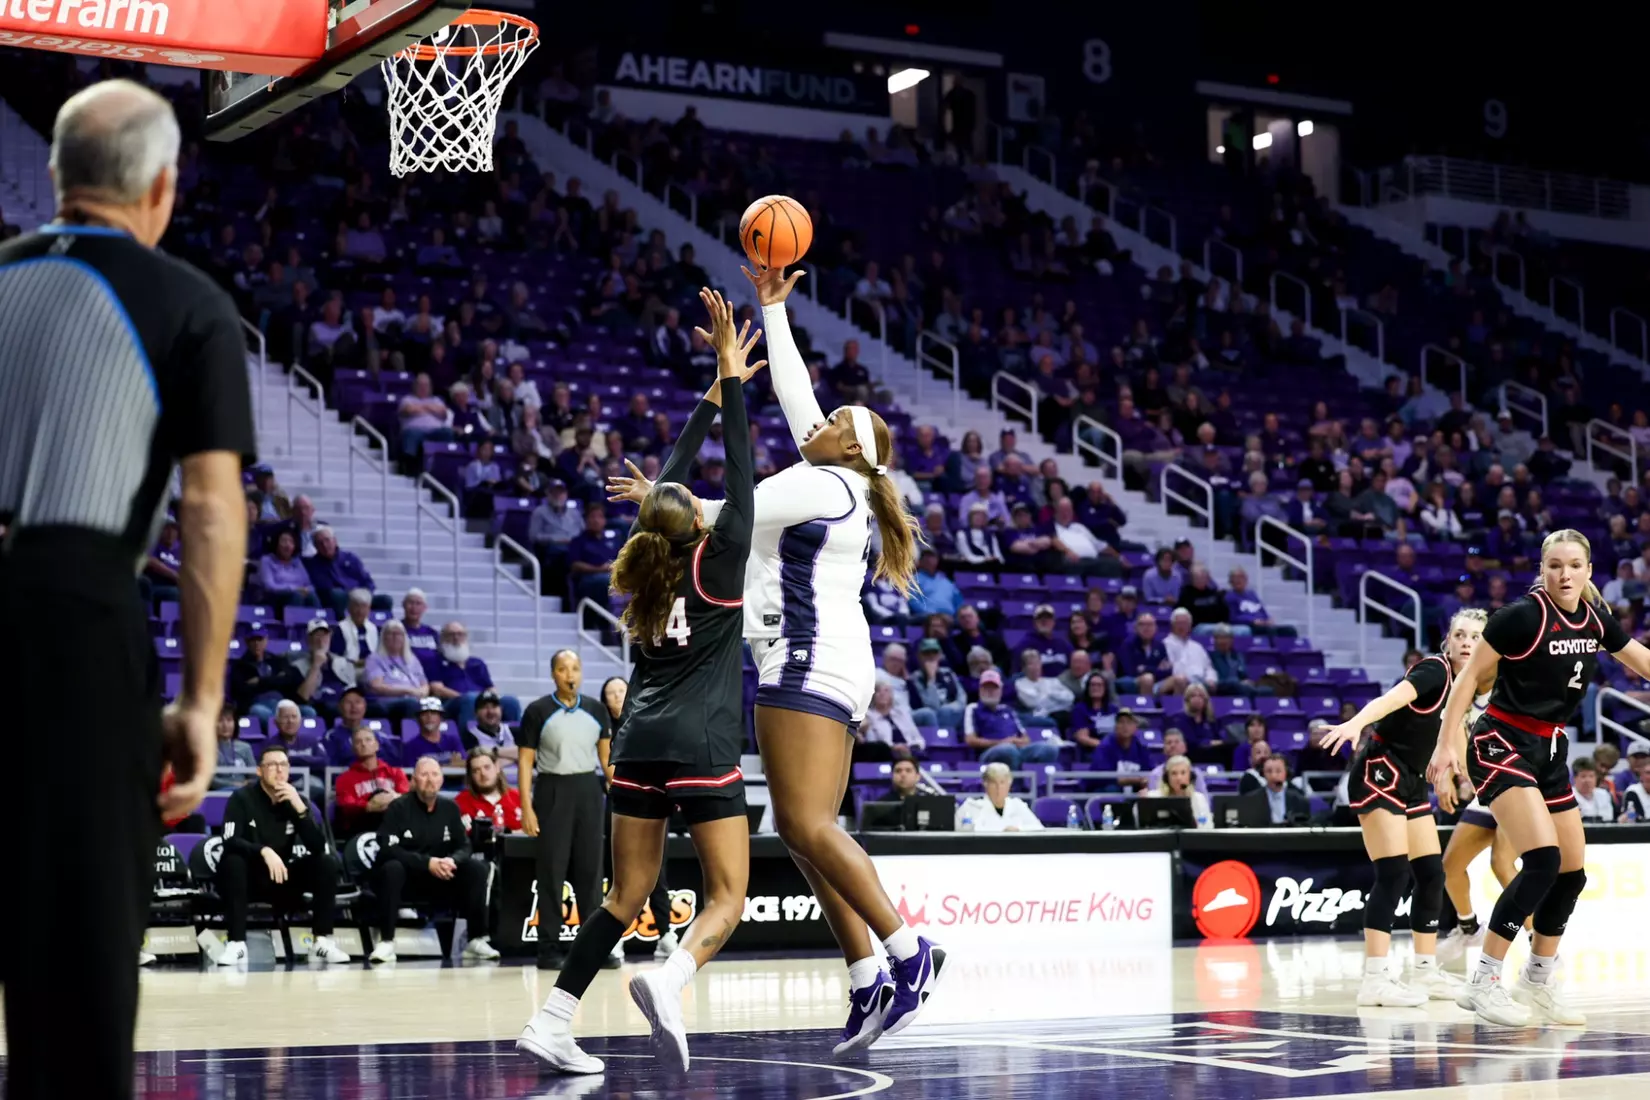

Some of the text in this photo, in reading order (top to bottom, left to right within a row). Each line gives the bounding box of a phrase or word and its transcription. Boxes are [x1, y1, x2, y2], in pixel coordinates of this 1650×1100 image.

[1083, 38, 1111, 83] 8
[1484, 99, 1508, 138] 9
[1567, 660, 1584, 689] 2
[938, 894, 1082, 926] SMOOTHIE
[1265, 876, 1365, 927] Pizza
